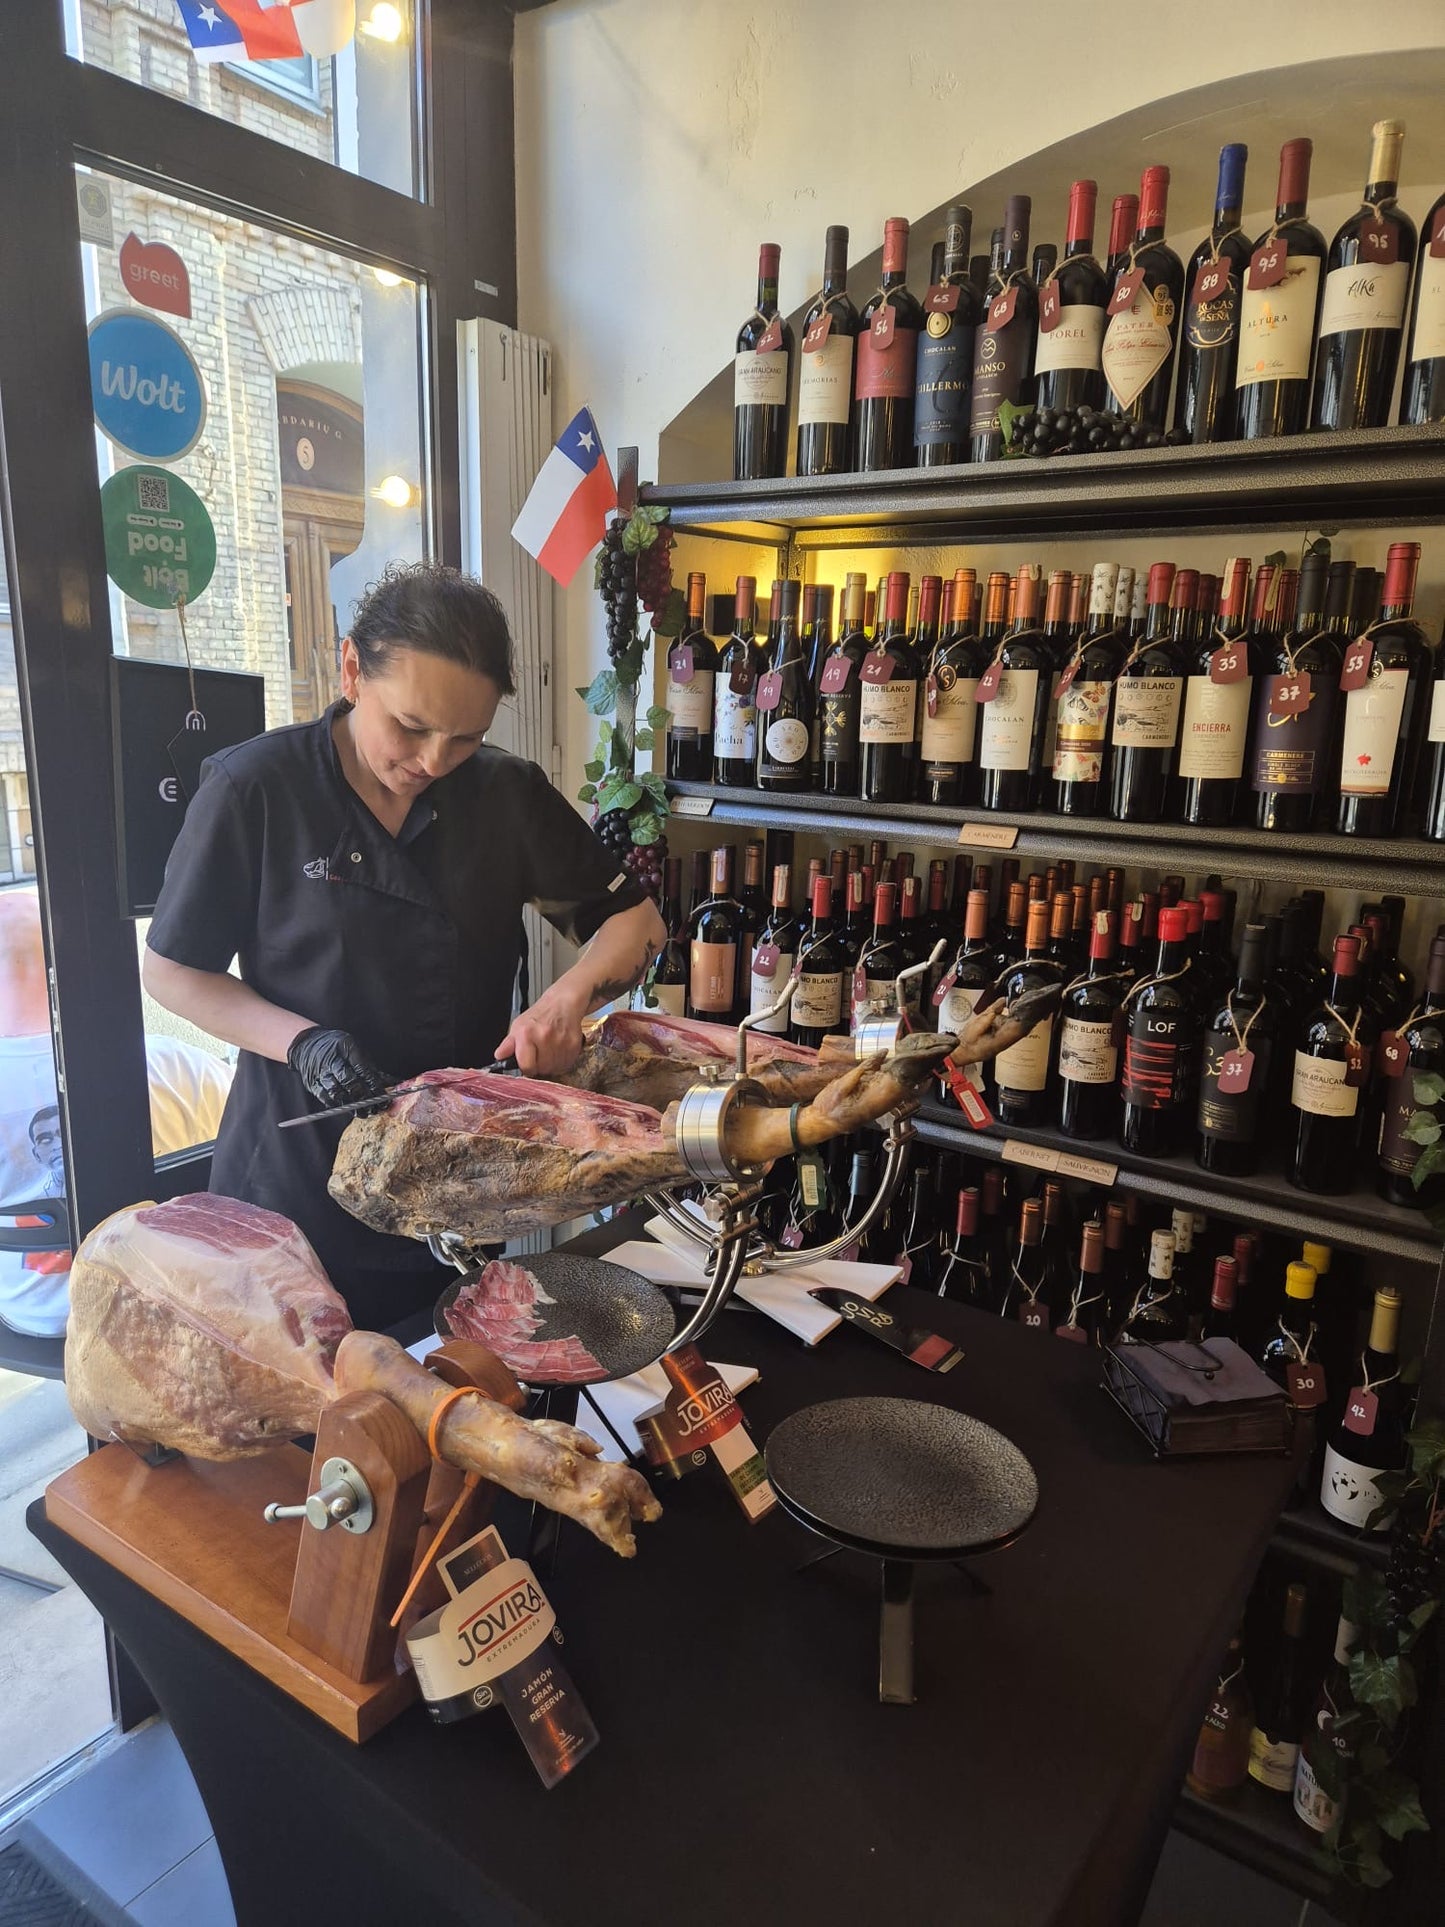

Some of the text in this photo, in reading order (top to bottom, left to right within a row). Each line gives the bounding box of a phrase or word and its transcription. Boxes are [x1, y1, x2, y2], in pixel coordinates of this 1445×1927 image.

[1368, 233, 1388, 249] 95
[1258, 253, 1278, 272] 95
[129, 263, 180, 290] greet
[1202, 274, 1219, 290] 88
[932, 293, 950, 304] 65
[1115, 287, 1131, 302] 80
[993, 304, 1007, 317] 68
[1198, 300, 1234, 311] ROCAS
[875, 320, 888, 336] 56
[1247, 314, 1288, 329] ALTURA
[101, 360, 186, 414] Wolt
[127, 531, 187, 561] Food
[1218, 655, 1237, 671] 35
[881, 685, 911, 693] BLANCO
[1140, 682, 1175, 690] BLANCO
[1279, 686, 1301, 701] 37
[1192, 722, 1231, 733] ENCIERRA
[1147, 1019, 1177, 1034] LOF
[1385, 1046, 1398, 1061] 68
[1226, 1062, 1244, 1076] 37
[1310, 1073, 1346, 1086] ARAUCAN
[1063, 1159, 1112, 1178] SAUVIGNON
[1295, 1377, 1315, 1390] 30
[677, 1382, 736, 1437] JOVIRA
[1350, 1404, 1366, 1418] 42
[457, 1582, 543, 1667] JOVIRA
[486, 1617, 541, 1663] EXTREMADURA
[520, 1666, 555, 1698] JAMÓN
[531, 1683, 555, 1705] GRAN
[529, 1689, 566, 1723] RESERVA
[1212, 1702, 1229, 1719] 22
